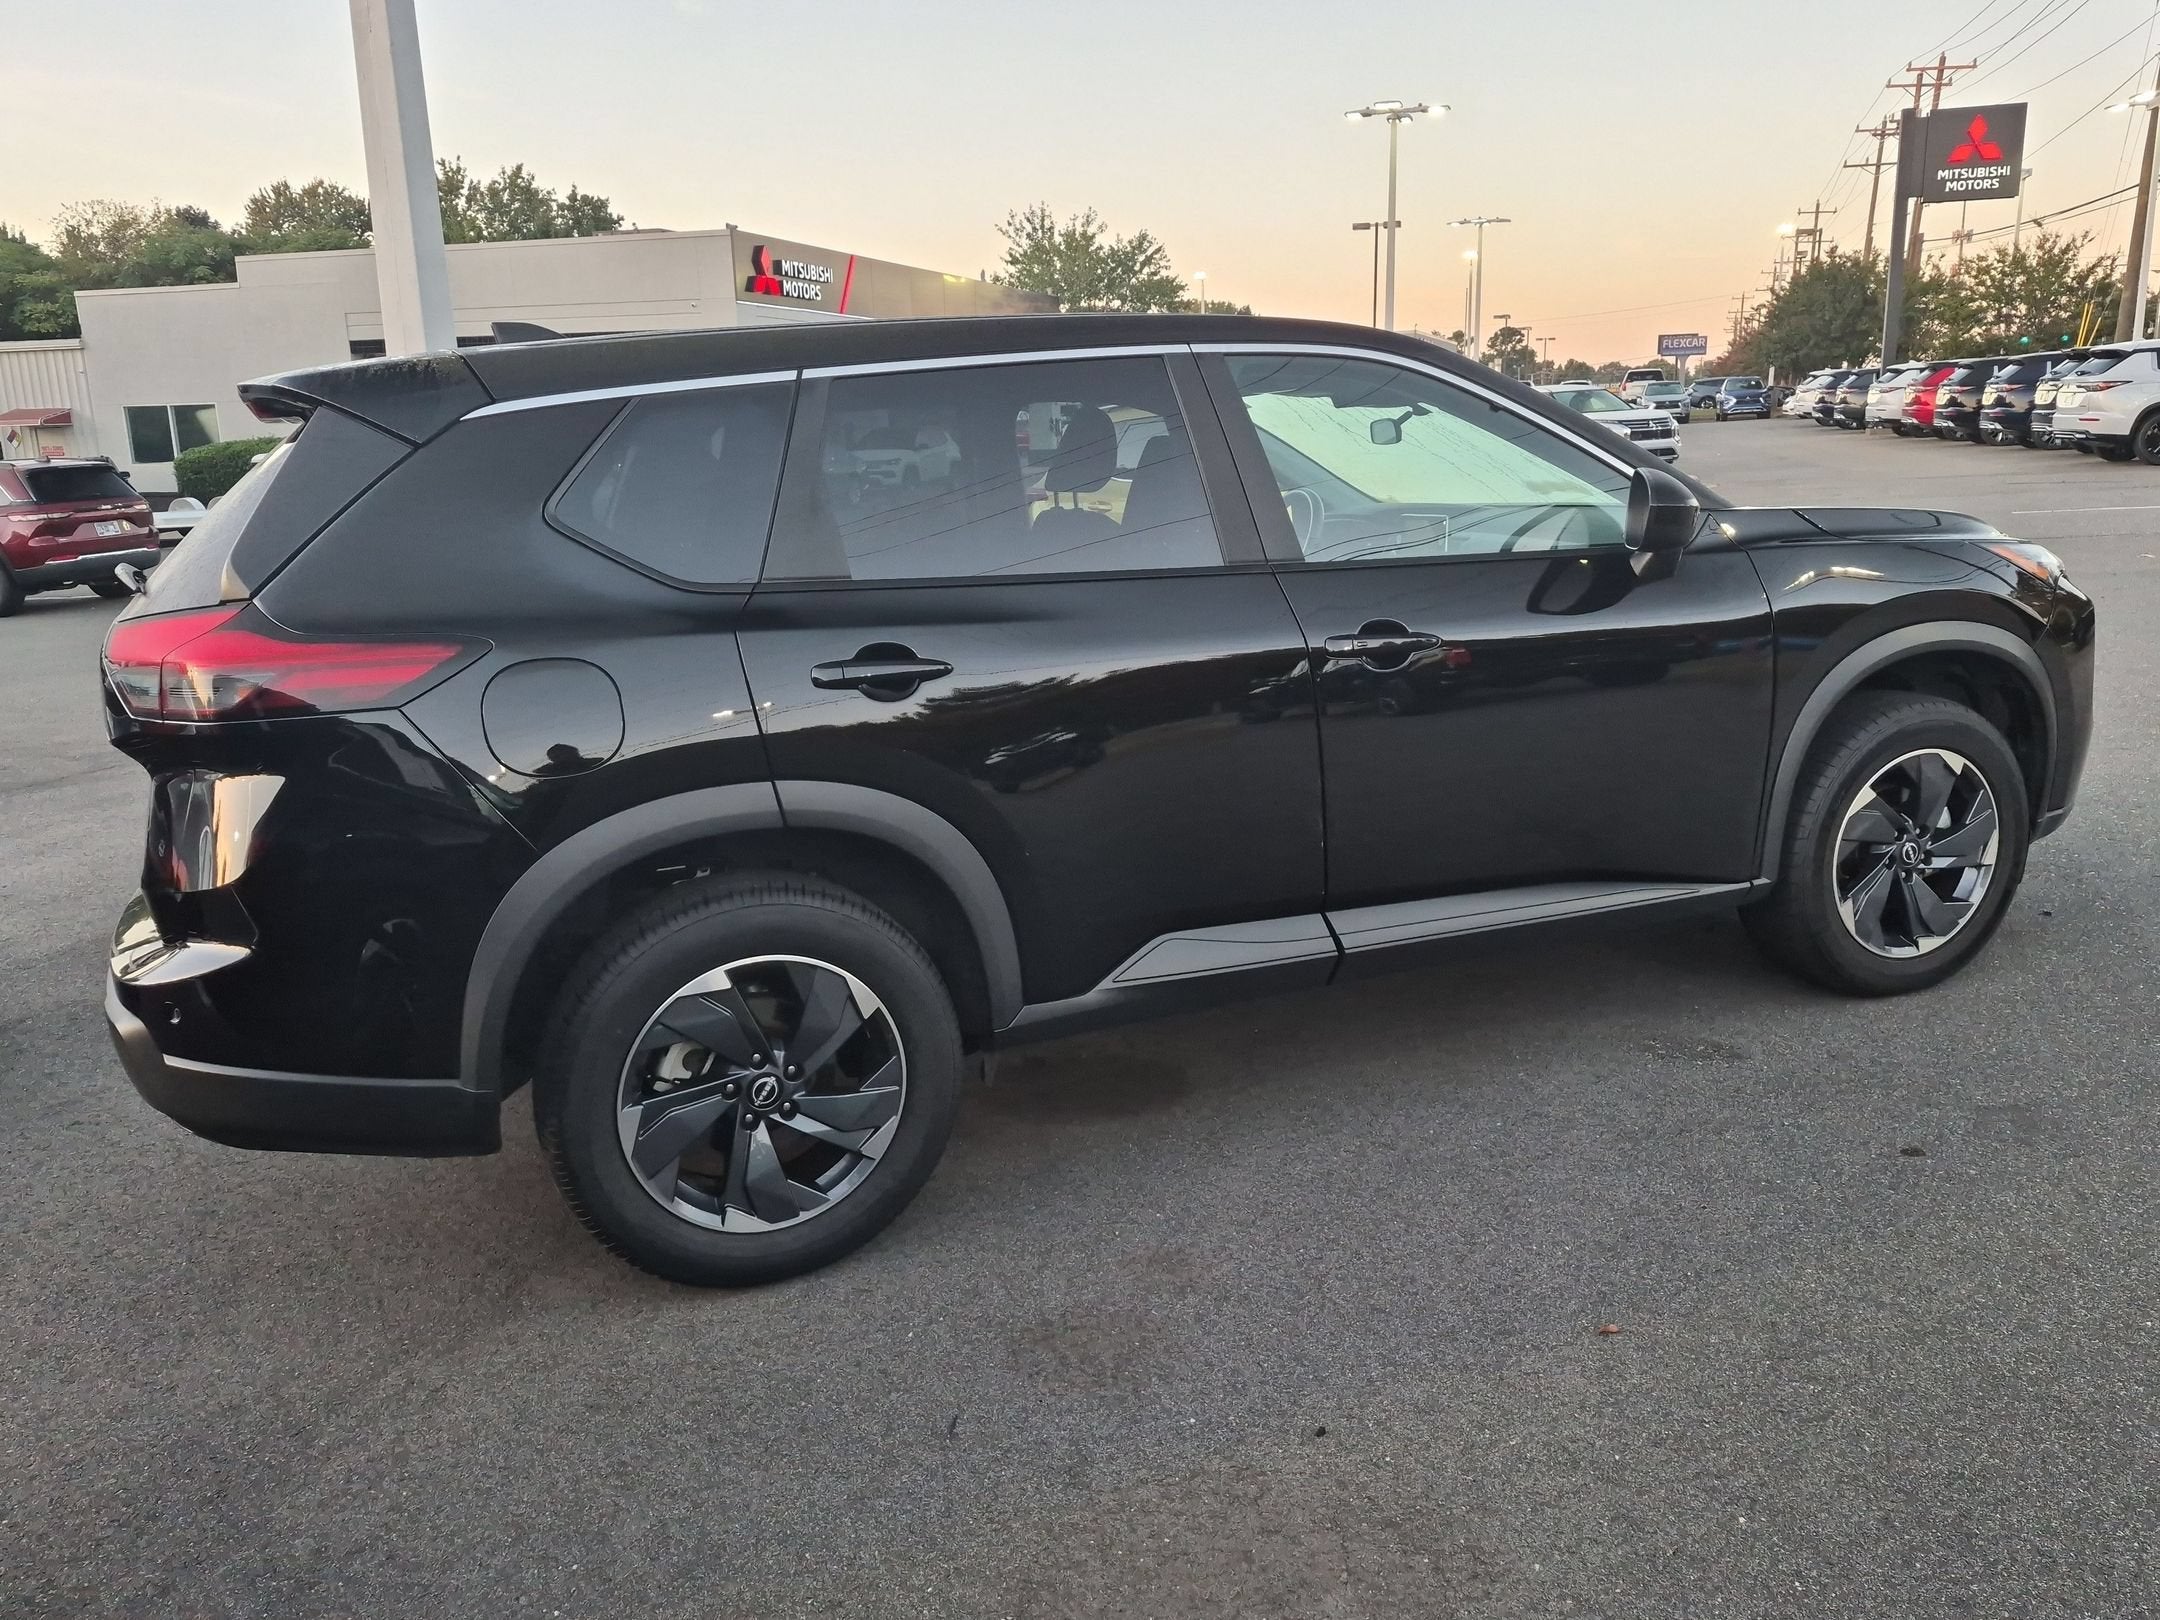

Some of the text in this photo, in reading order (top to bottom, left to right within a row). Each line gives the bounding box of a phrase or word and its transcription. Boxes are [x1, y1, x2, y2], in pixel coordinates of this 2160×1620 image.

[1937, 165, 2011, 180] MITSUBISHI
[1944, 178, 2000, 192] MOTORS
[781, 259, 833, 283] MITSUBISHI
[783, 279, 822, 301] MOTORS
[1662, 337, 1706, 349] FLEXCAR
